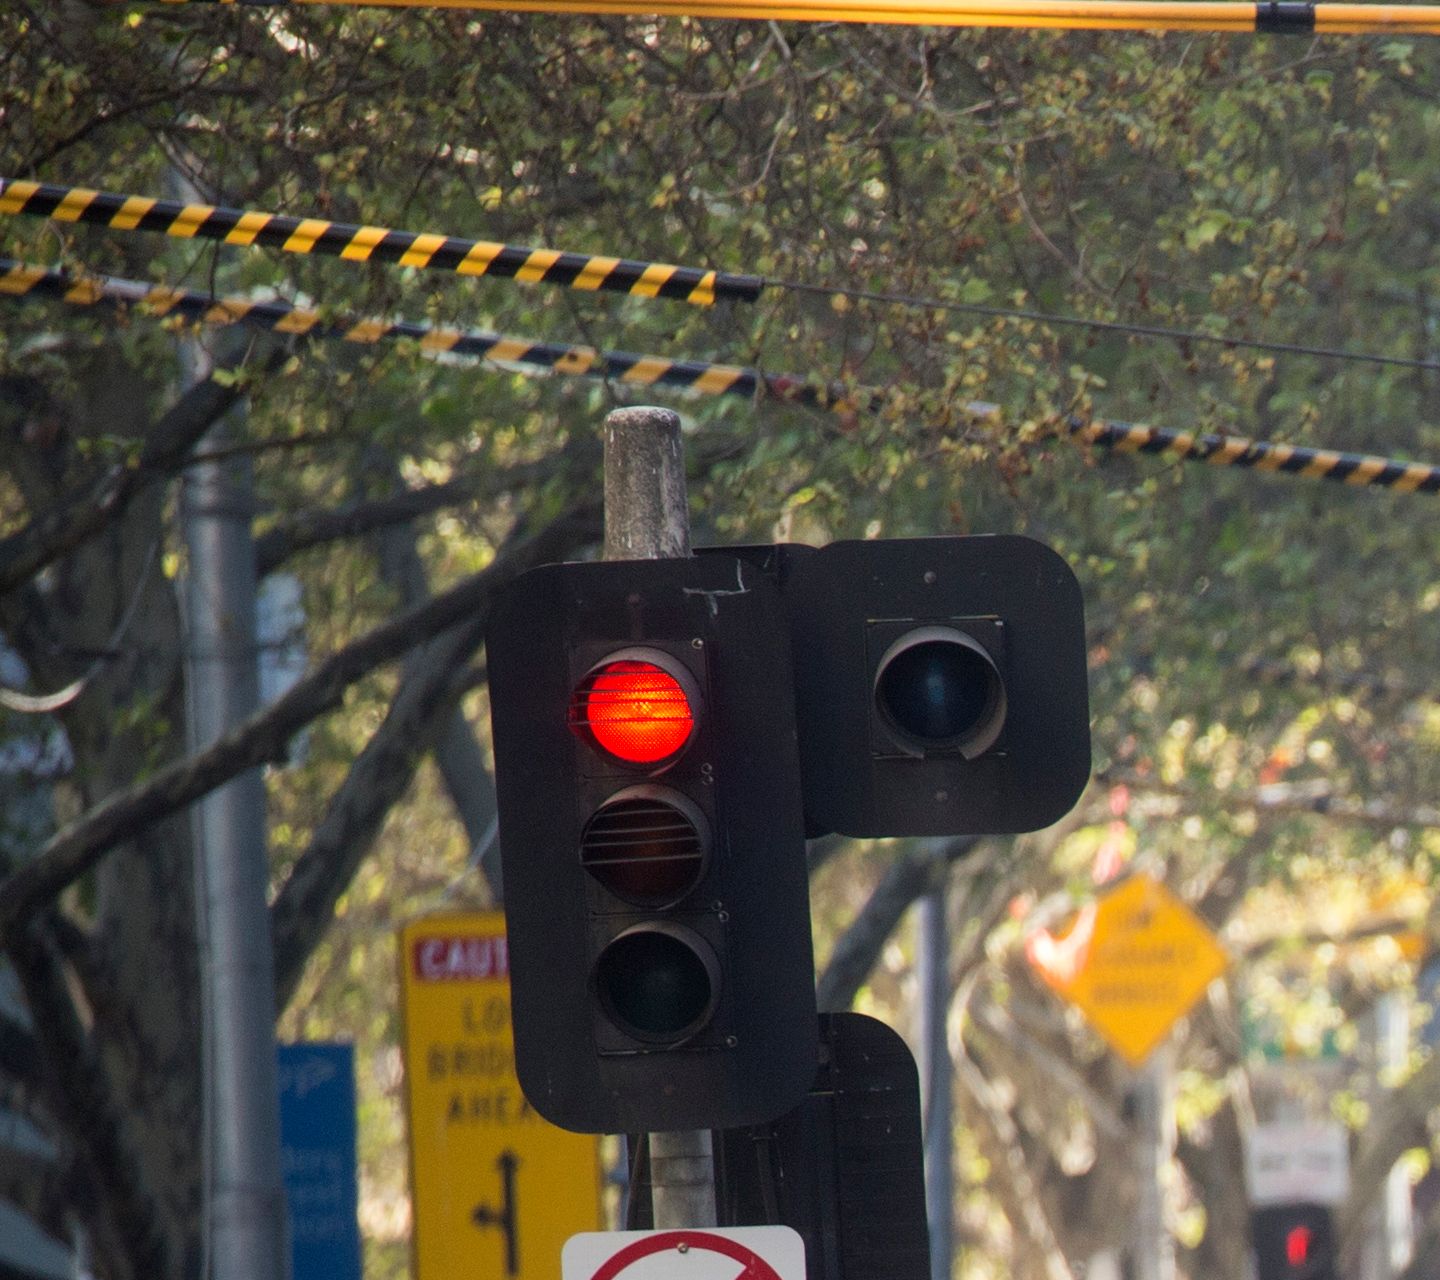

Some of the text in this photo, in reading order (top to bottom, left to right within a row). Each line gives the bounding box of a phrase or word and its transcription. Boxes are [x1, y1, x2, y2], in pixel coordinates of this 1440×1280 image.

[418, 937, 508, 978] CAUT
[461, 998, 508, 1035] LO
[449, 1094, 530, 1123] AHEA
